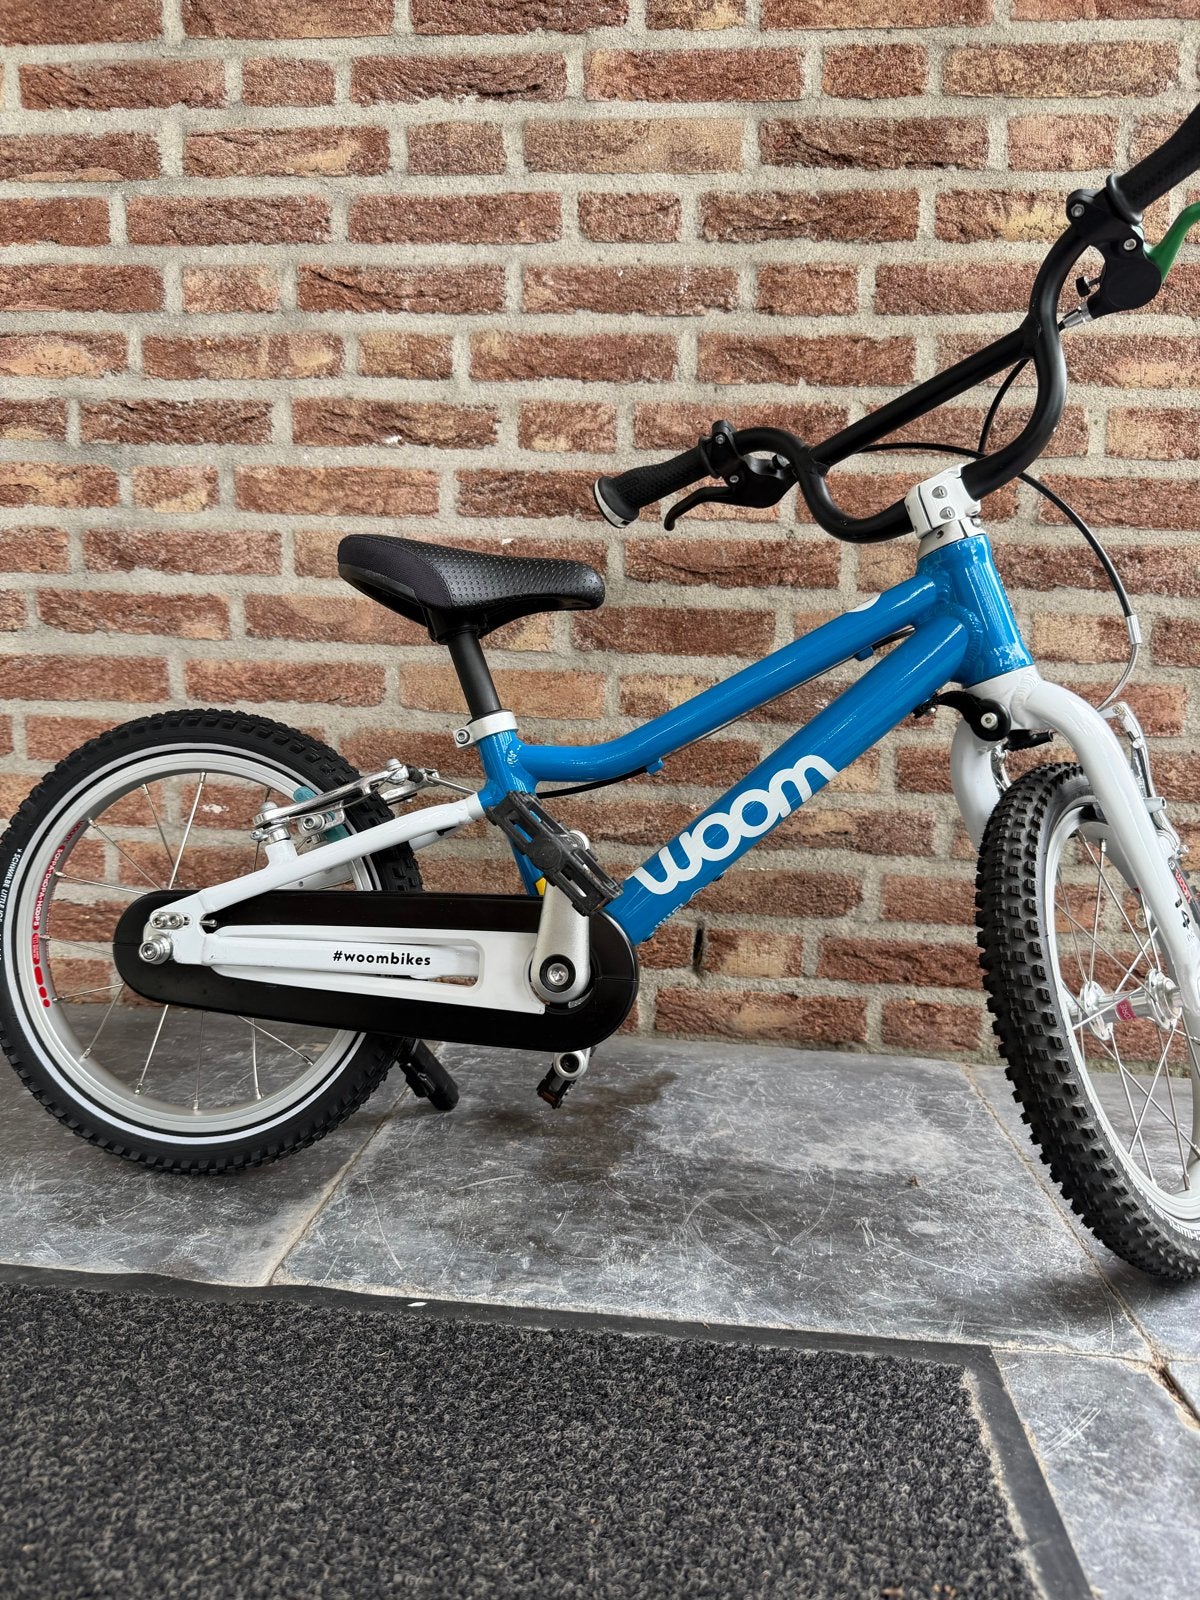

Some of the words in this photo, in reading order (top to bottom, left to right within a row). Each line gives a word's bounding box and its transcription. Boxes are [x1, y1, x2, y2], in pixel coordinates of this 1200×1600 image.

[625, 754, 839, 895] woom
[2, 852, 22, 888] SCHWALBE
[333, 950, 431, 966] #woombikes
